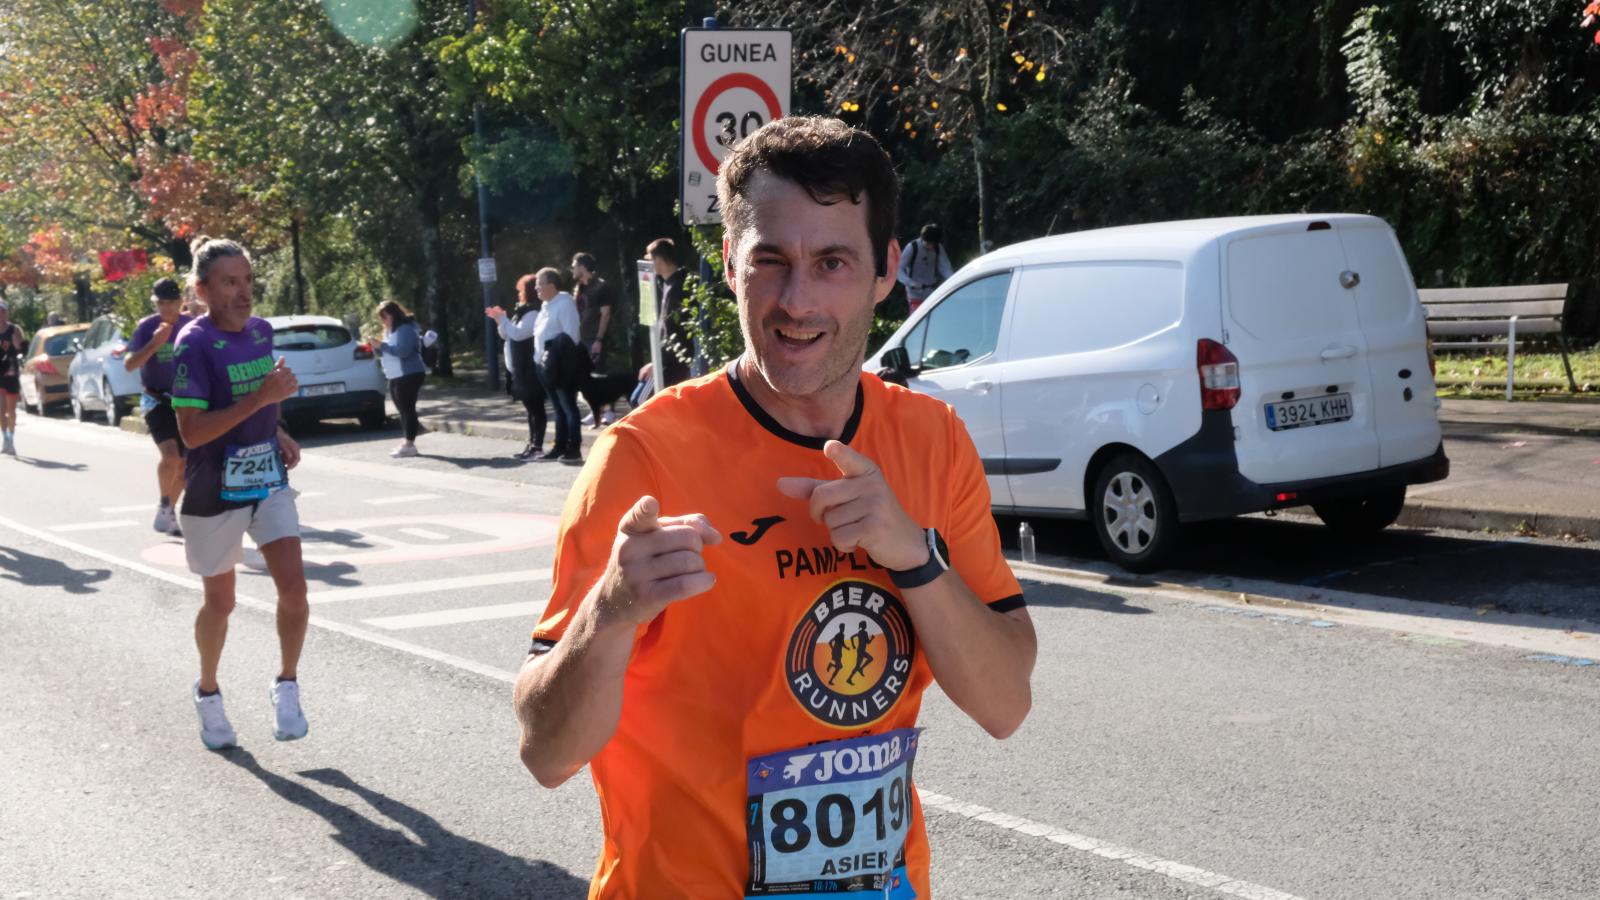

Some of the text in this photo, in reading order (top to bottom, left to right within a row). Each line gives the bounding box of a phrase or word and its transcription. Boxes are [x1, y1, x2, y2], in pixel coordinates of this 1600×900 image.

[701, 43, 777, 63] GUNEA
[715, 110, 764, 147] 30
[1278, 397, 1349, 424] 3924 KHH
[230, 455, 274, 476] 7241
[814, 586, 886, 624] BEER
[794, 657, 910, 721] RUNNERS
[820, 851, 889, 876] ASIER
